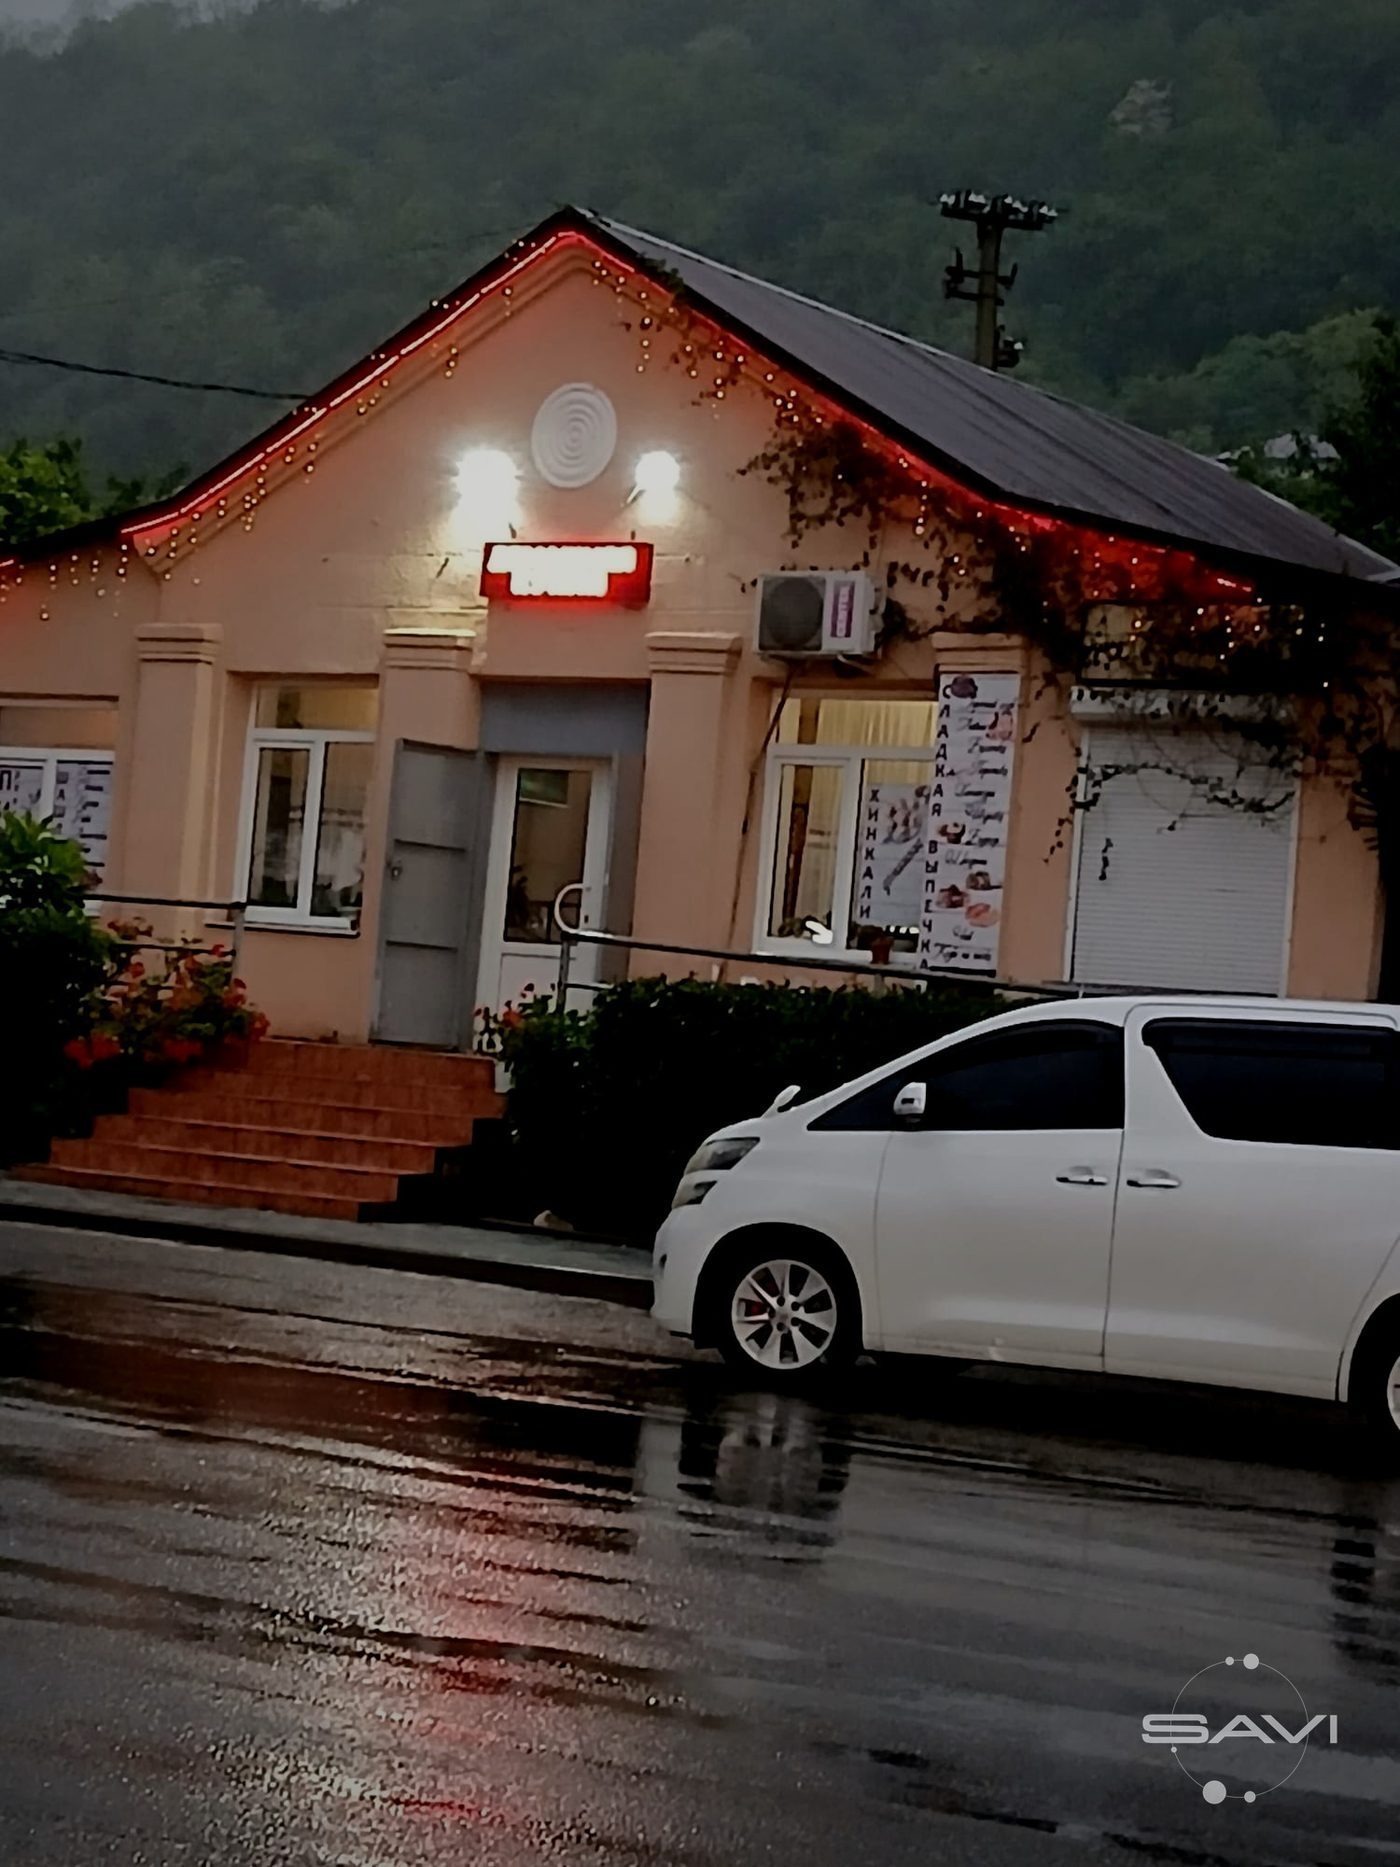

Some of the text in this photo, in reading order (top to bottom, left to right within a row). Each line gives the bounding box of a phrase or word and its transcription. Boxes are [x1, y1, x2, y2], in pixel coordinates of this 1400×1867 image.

[860, 789, 879, 919] ХИНКАЛИ
[920, 685, 952, 971] СЛАДКАЯ ВЫПЕЧКА
